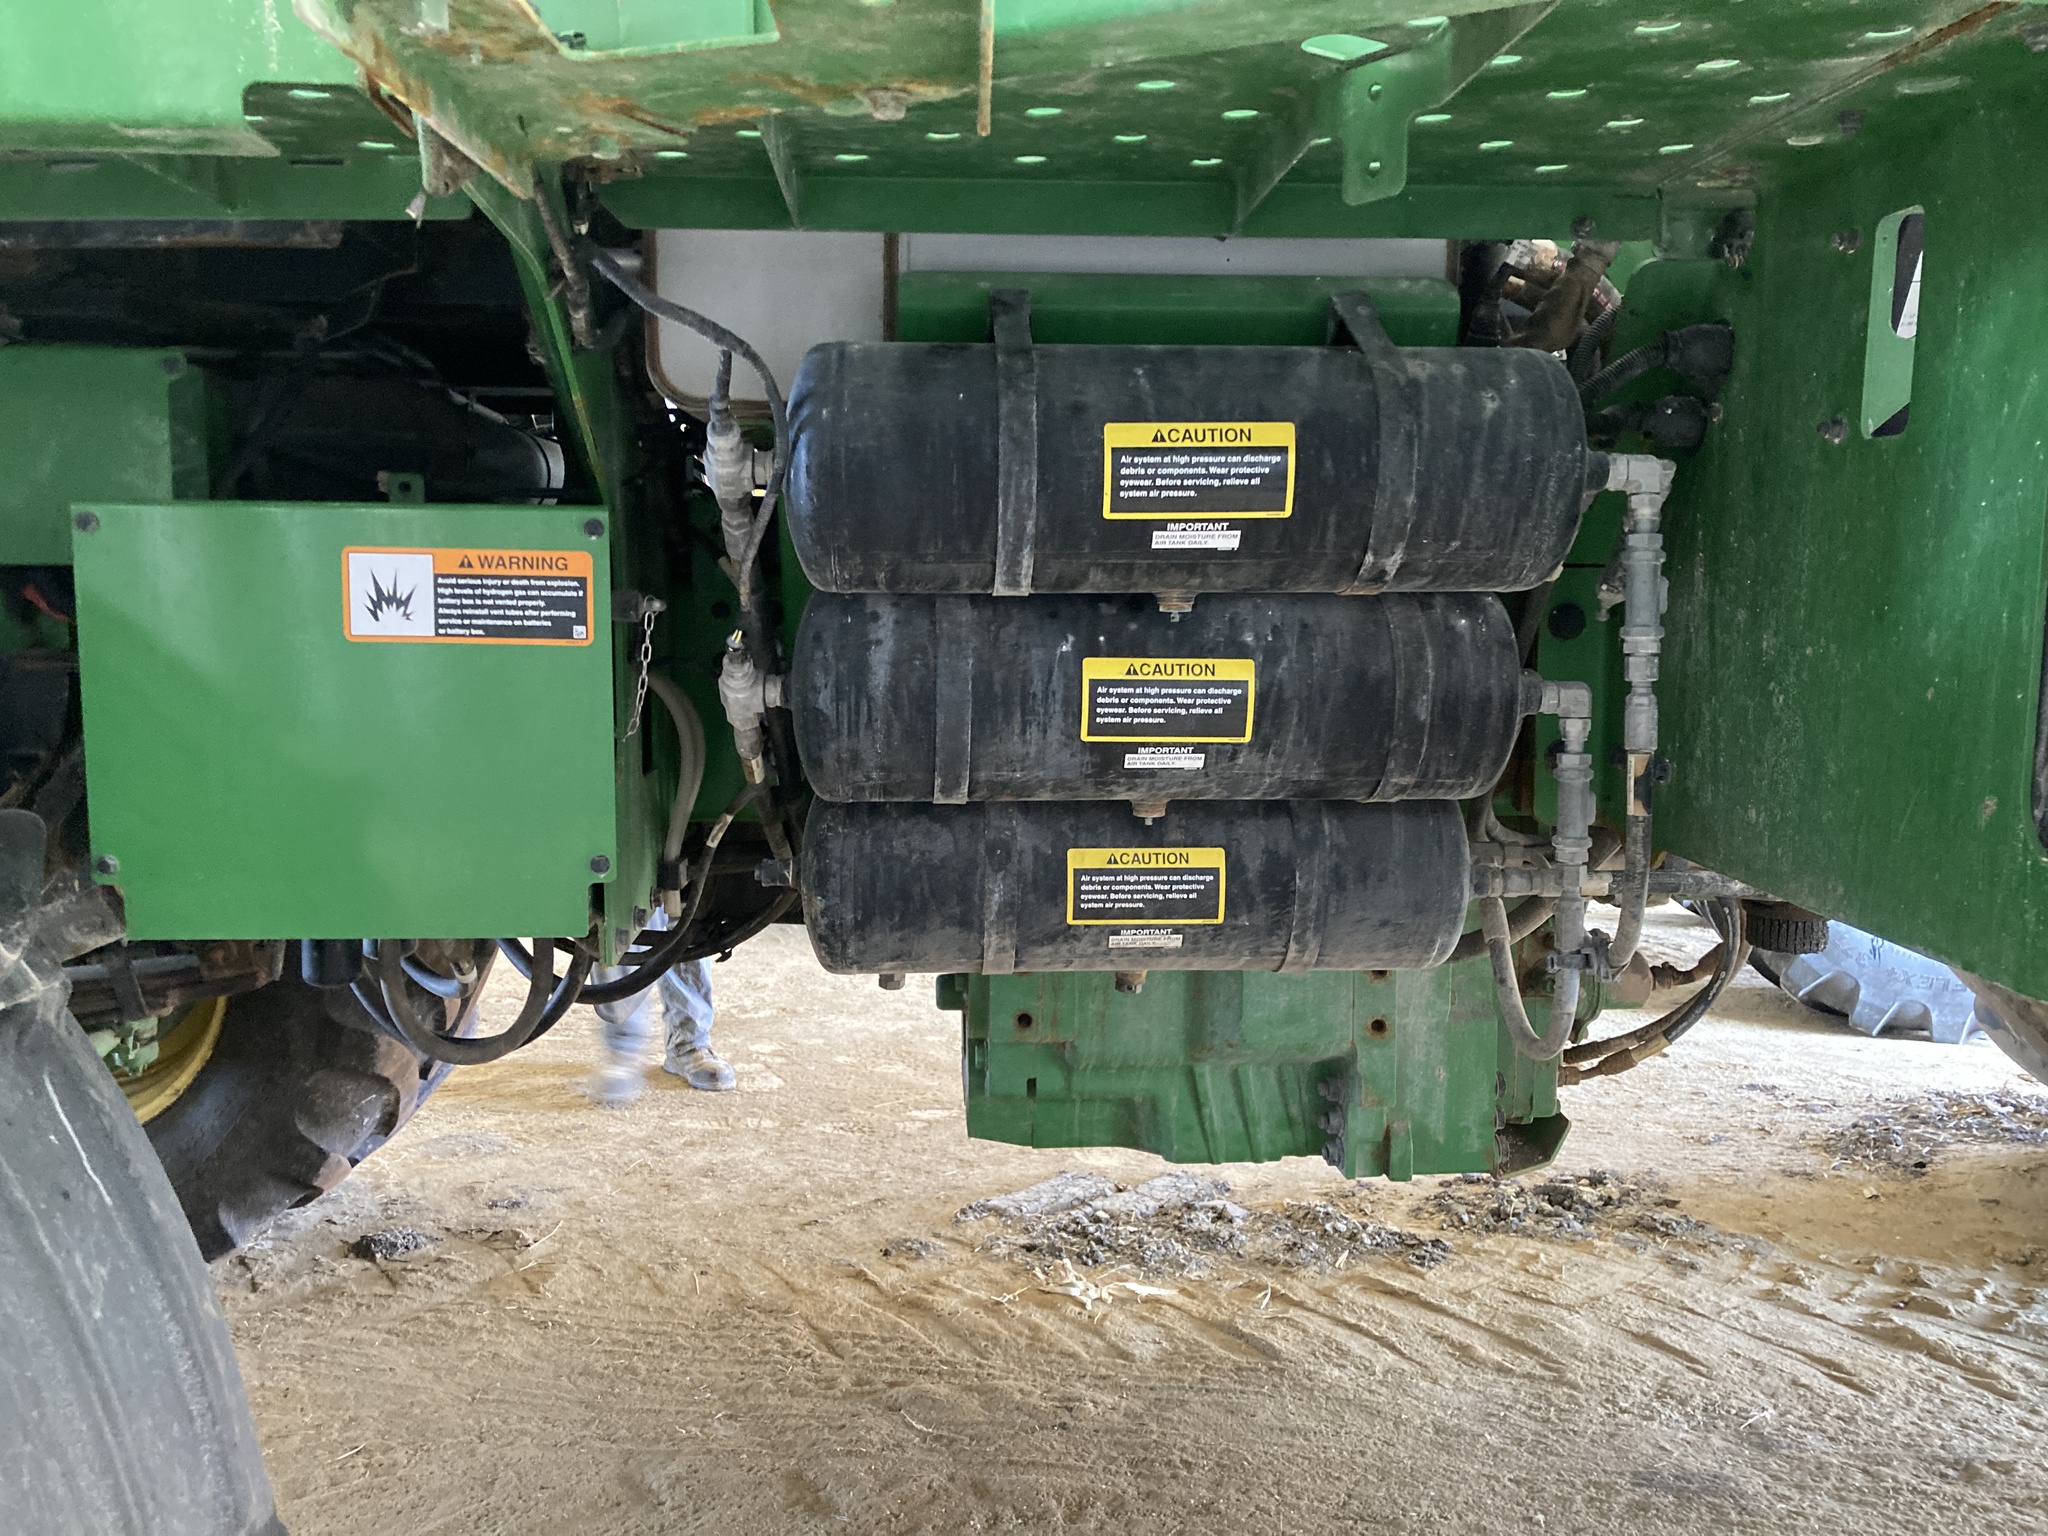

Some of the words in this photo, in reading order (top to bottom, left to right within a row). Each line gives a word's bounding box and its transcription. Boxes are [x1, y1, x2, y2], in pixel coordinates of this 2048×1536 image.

[1168, 429, 1251, 442] CAUTION
[1134, 456, 1161, 464] system
[1173, 456, 1190, 464] high
[1192, 456, 1225, 464] pressure
[1243, 455, 1281, 463] discharge
[1157, 468, 1208, 476] components.
[1209, 466, 1228, 474] Wear
[1230, 466, 1269, 475] protective
[1156, 478, 1181, 486] Before
[1183, 478, 1221, 487] servicing,
[1120, 490, 1147, 498] system
[1161, 490, 1197, 498] pressure.
[1167, 523, 1229, 531] IMPORTANT
[478, 556, 568, 570] WARNING
[447, 628, 470, 636] battery
[1140, 664, 1215, 676] CAUTION
[1144, 687, 1159, 695] high
[1208, 688, 1242, 696] discharge
[1153, 707, 1187, 715] servicing,
[1120, 853, 1189, 864] CAUTION
